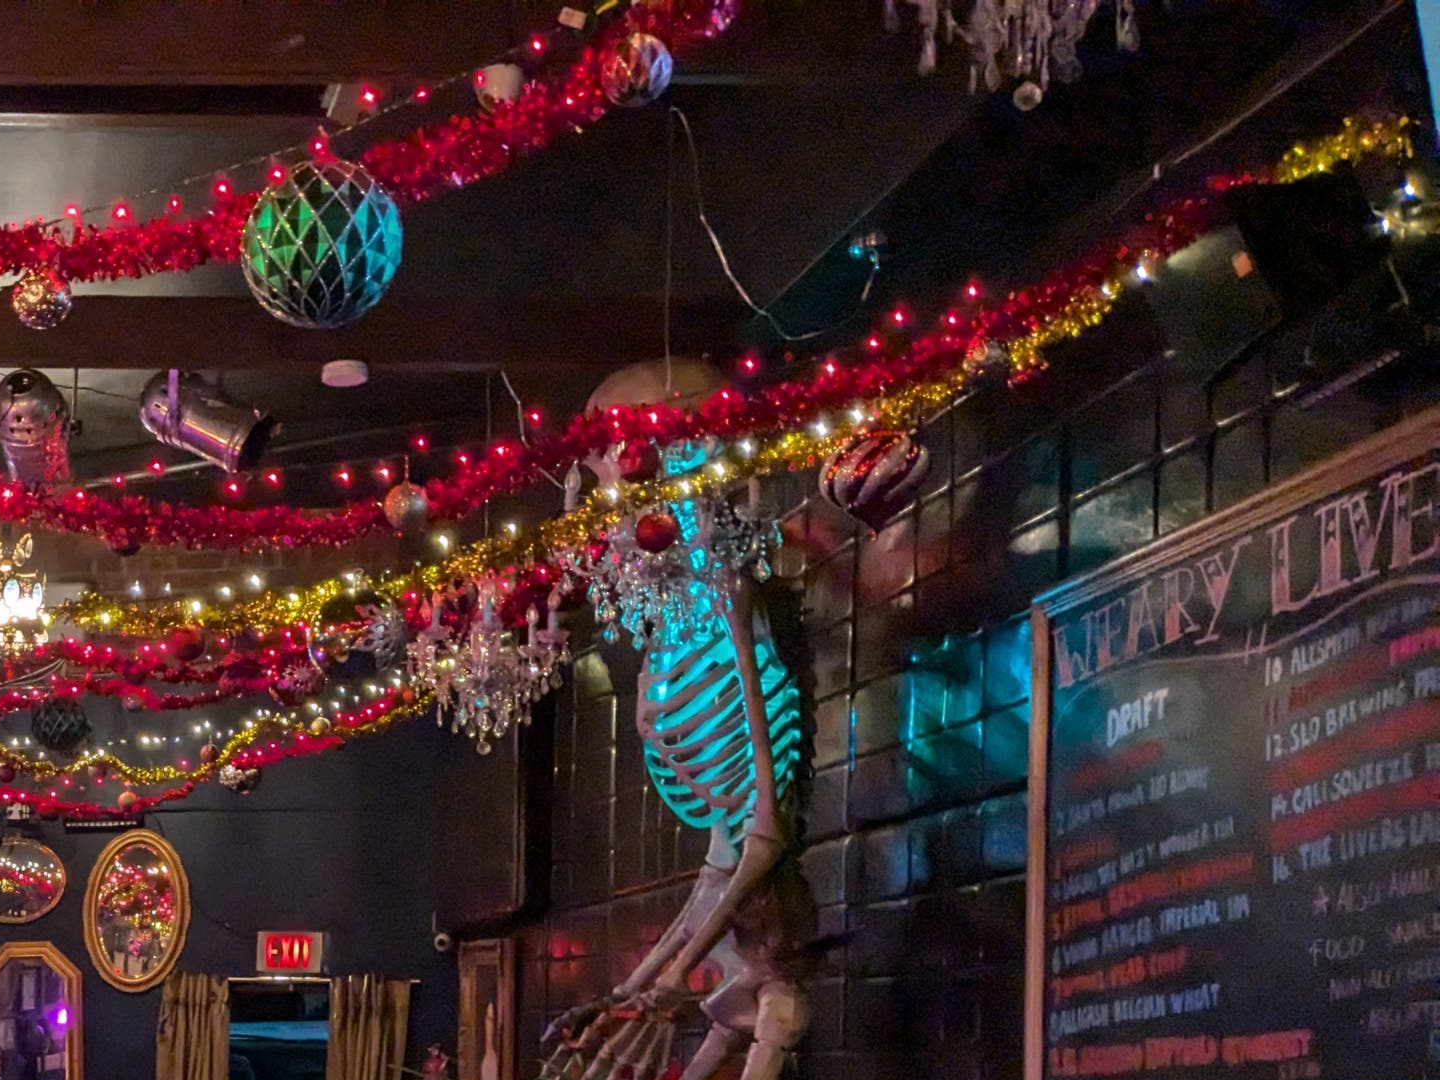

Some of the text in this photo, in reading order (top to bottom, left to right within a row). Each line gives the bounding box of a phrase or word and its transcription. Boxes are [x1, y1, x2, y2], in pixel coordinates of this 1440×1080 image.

[1053, 536, 1252, 688] WEARY
[1107, 688, 1169, 748] DRAFT
[1290, 716, 1320, 754] SLO
[266, 934, 313, 970] EXIT
